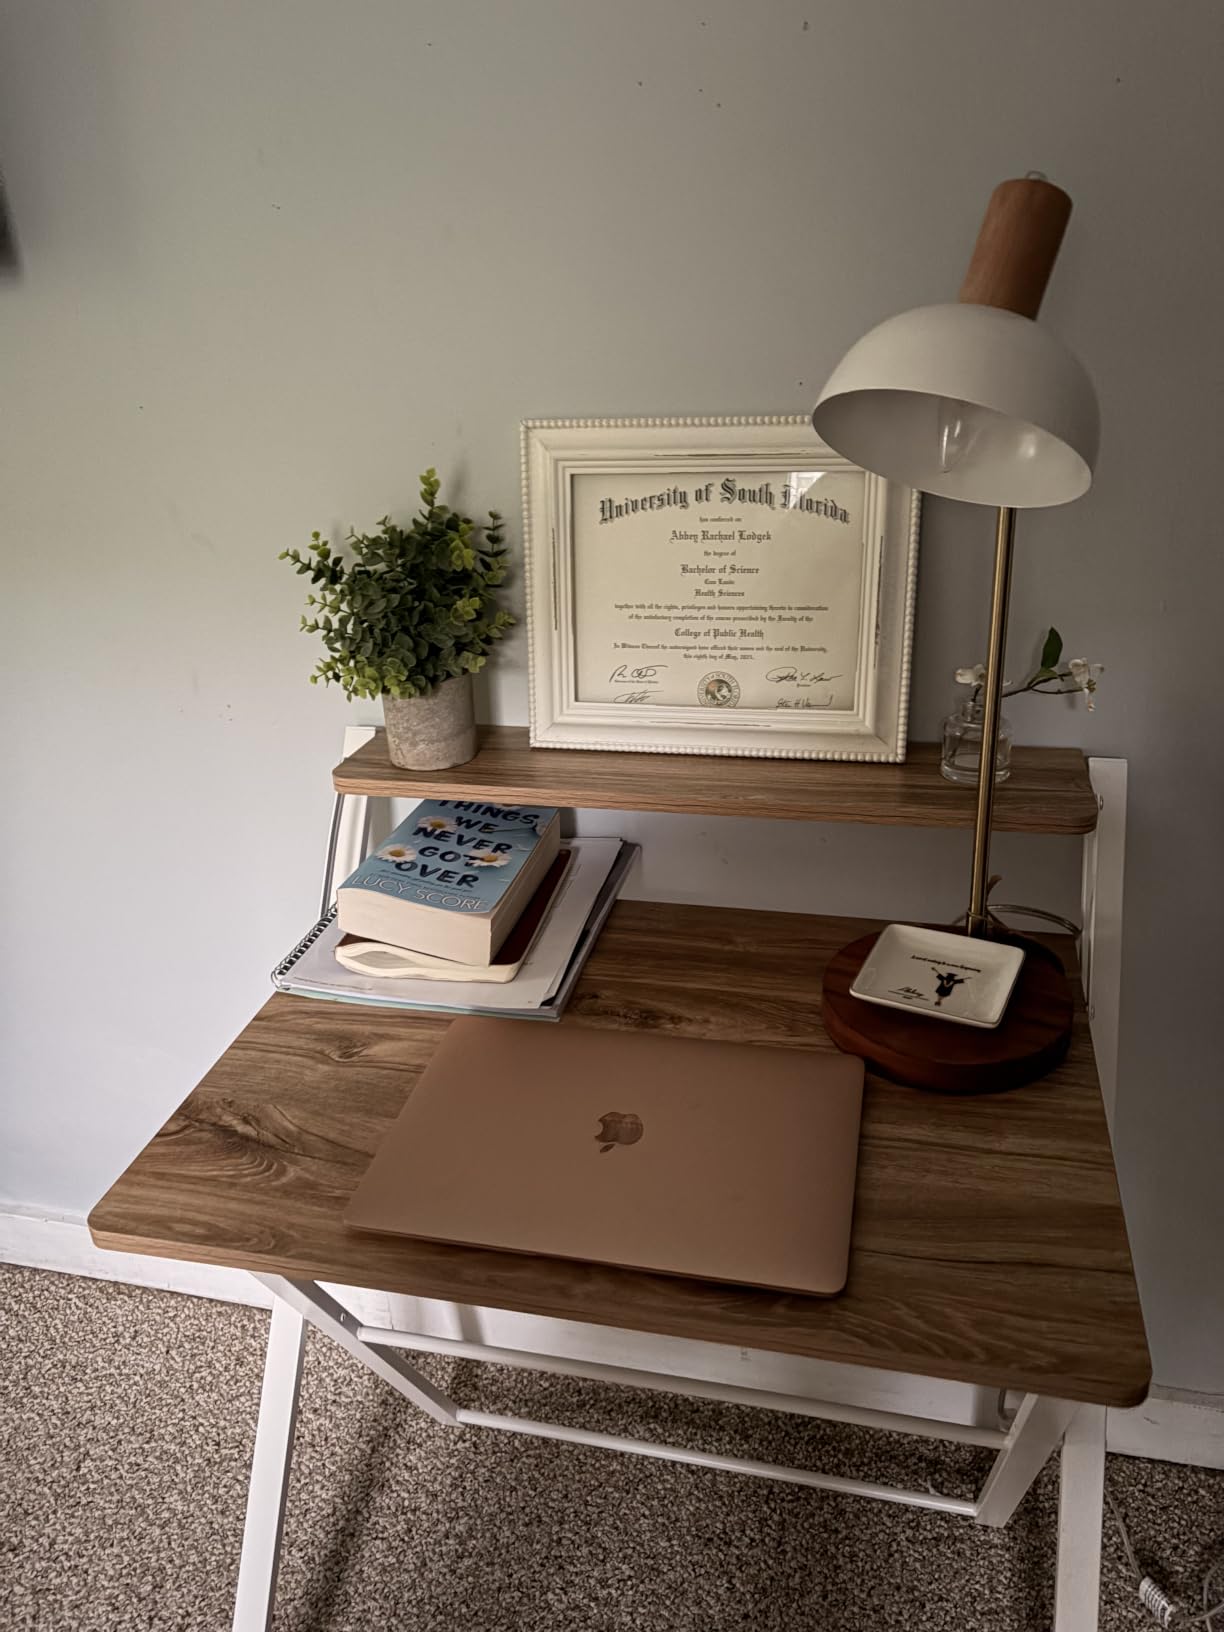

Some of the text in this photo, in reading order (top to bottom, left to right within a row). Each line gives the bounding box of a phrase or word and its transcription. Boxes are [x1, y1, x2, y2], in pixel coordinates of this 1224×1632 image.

[599, 484, 689, 525] University
[695, 482, 714, 504] of
[720, 477, 776, 510] South
[669, 529, 698, 544] Abbey
[701, 529, 735, 544] Rachael
[680, 564, 760, 576] Bachelor of Science
[694, 588, 744, 599] Health Sciences
[674, 627, 764, 640] College of Public Health
[455, 816, 499, 834] WE
[412, 827, 513, 855] NEVER
[394, 861, 480, 889] OVER
[351, 875, 411, 894] LUCY
[414, 889, 490, 911] SCORE
